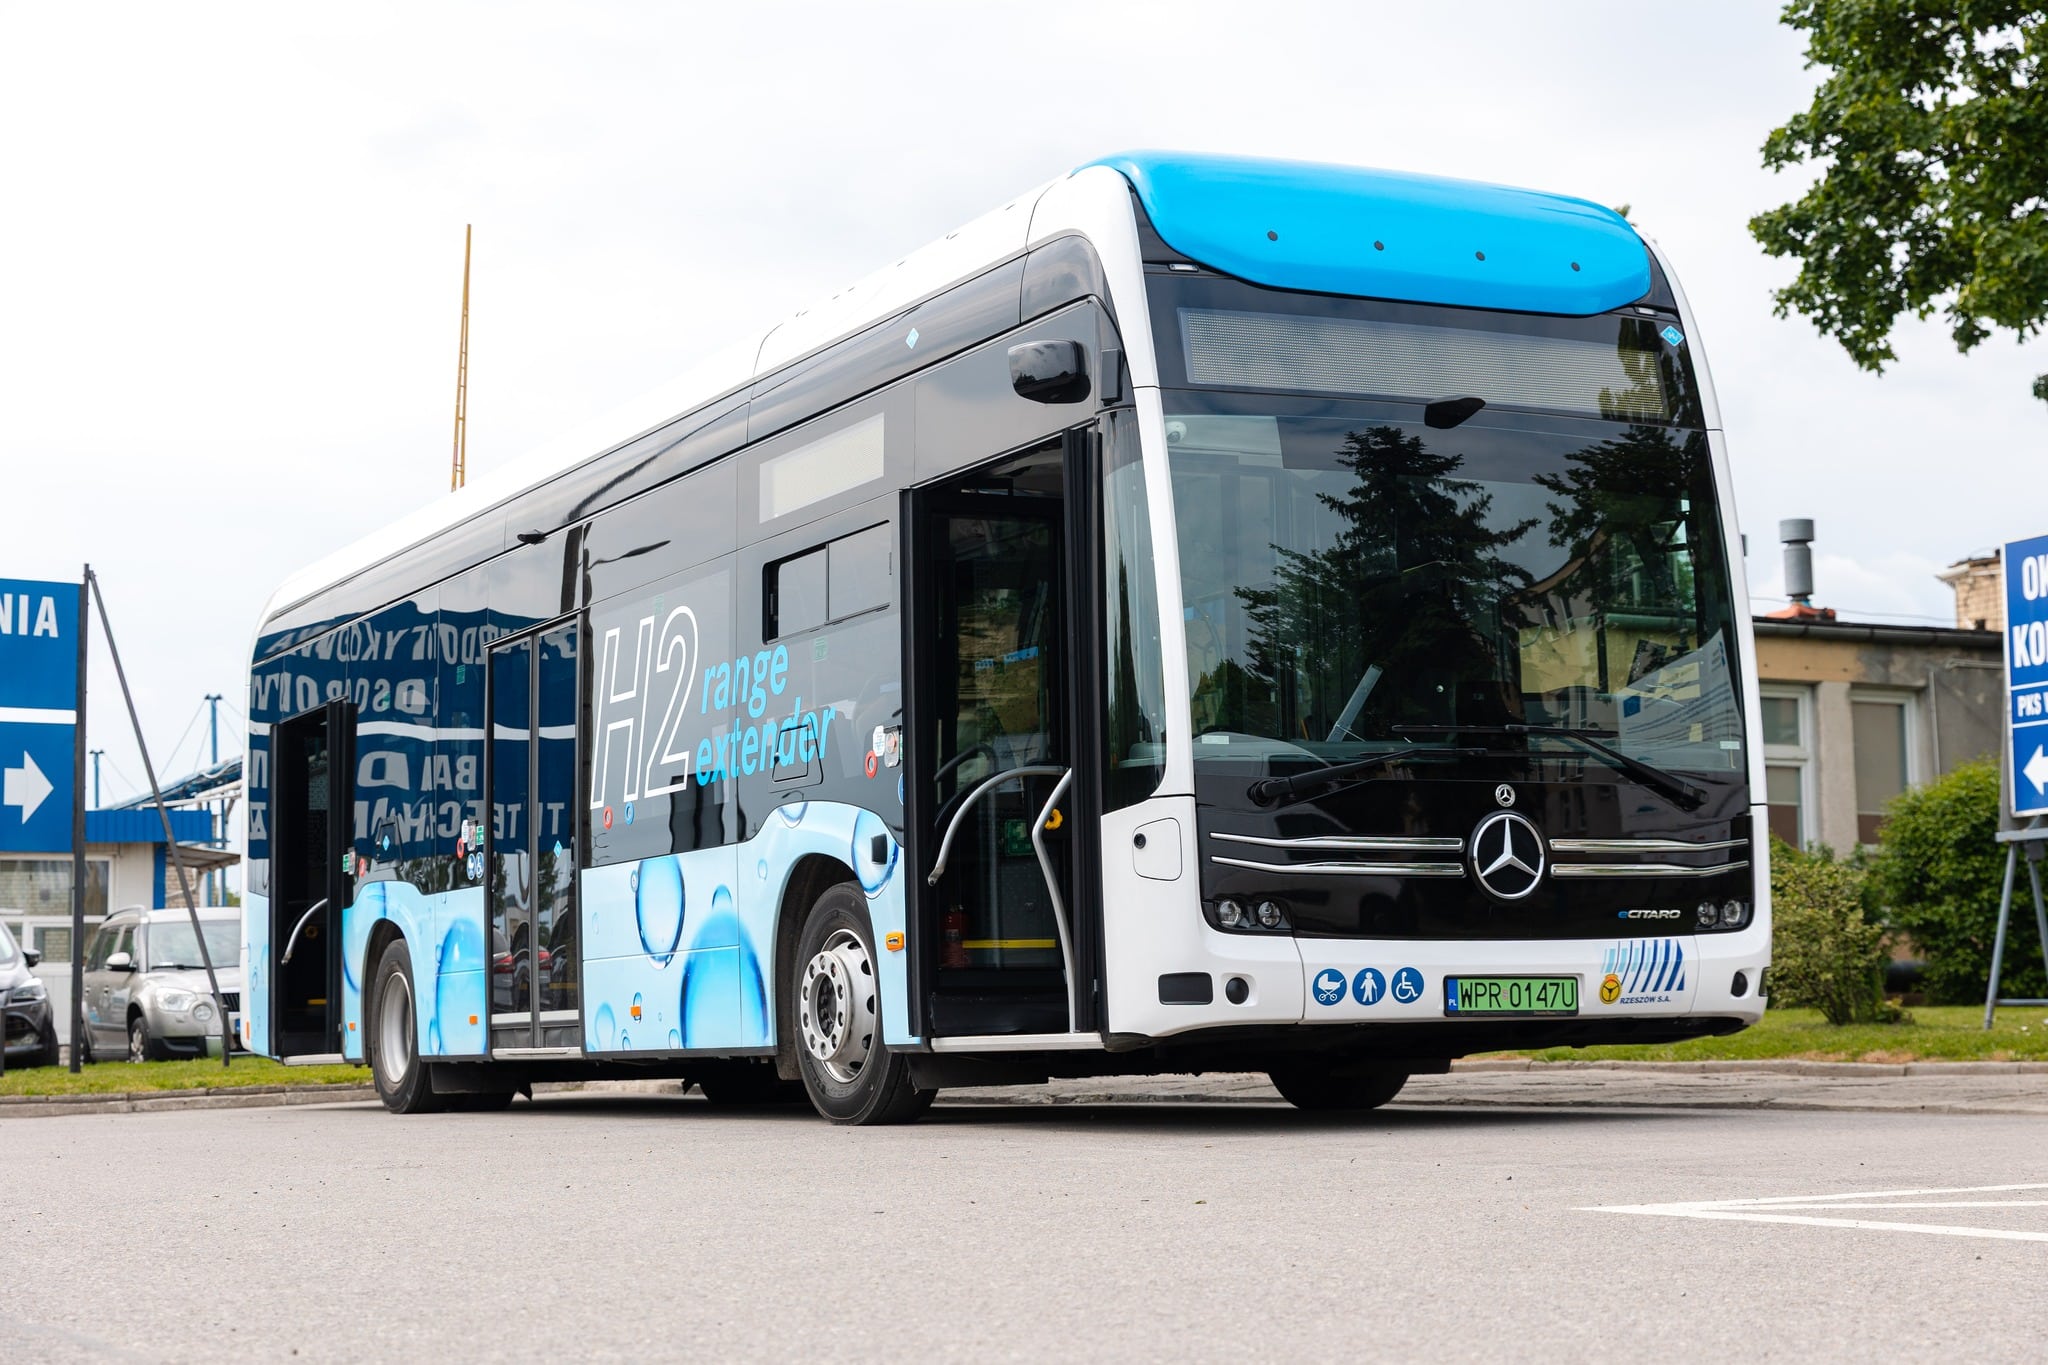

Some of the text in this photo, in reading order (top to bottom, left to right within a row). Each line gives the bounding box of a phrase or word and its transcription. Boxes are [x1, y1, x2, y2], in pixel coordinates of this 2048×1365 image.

[2012, 620, 2048, 668] KO
[589, 605, 699, 810] H2
[701, 644, 789, 719] range
[695, 696, 836, 787] extender
[1448, 998, 1457, 1007] PL
[1460, 982, 1574, 1008] WPR 0147U
